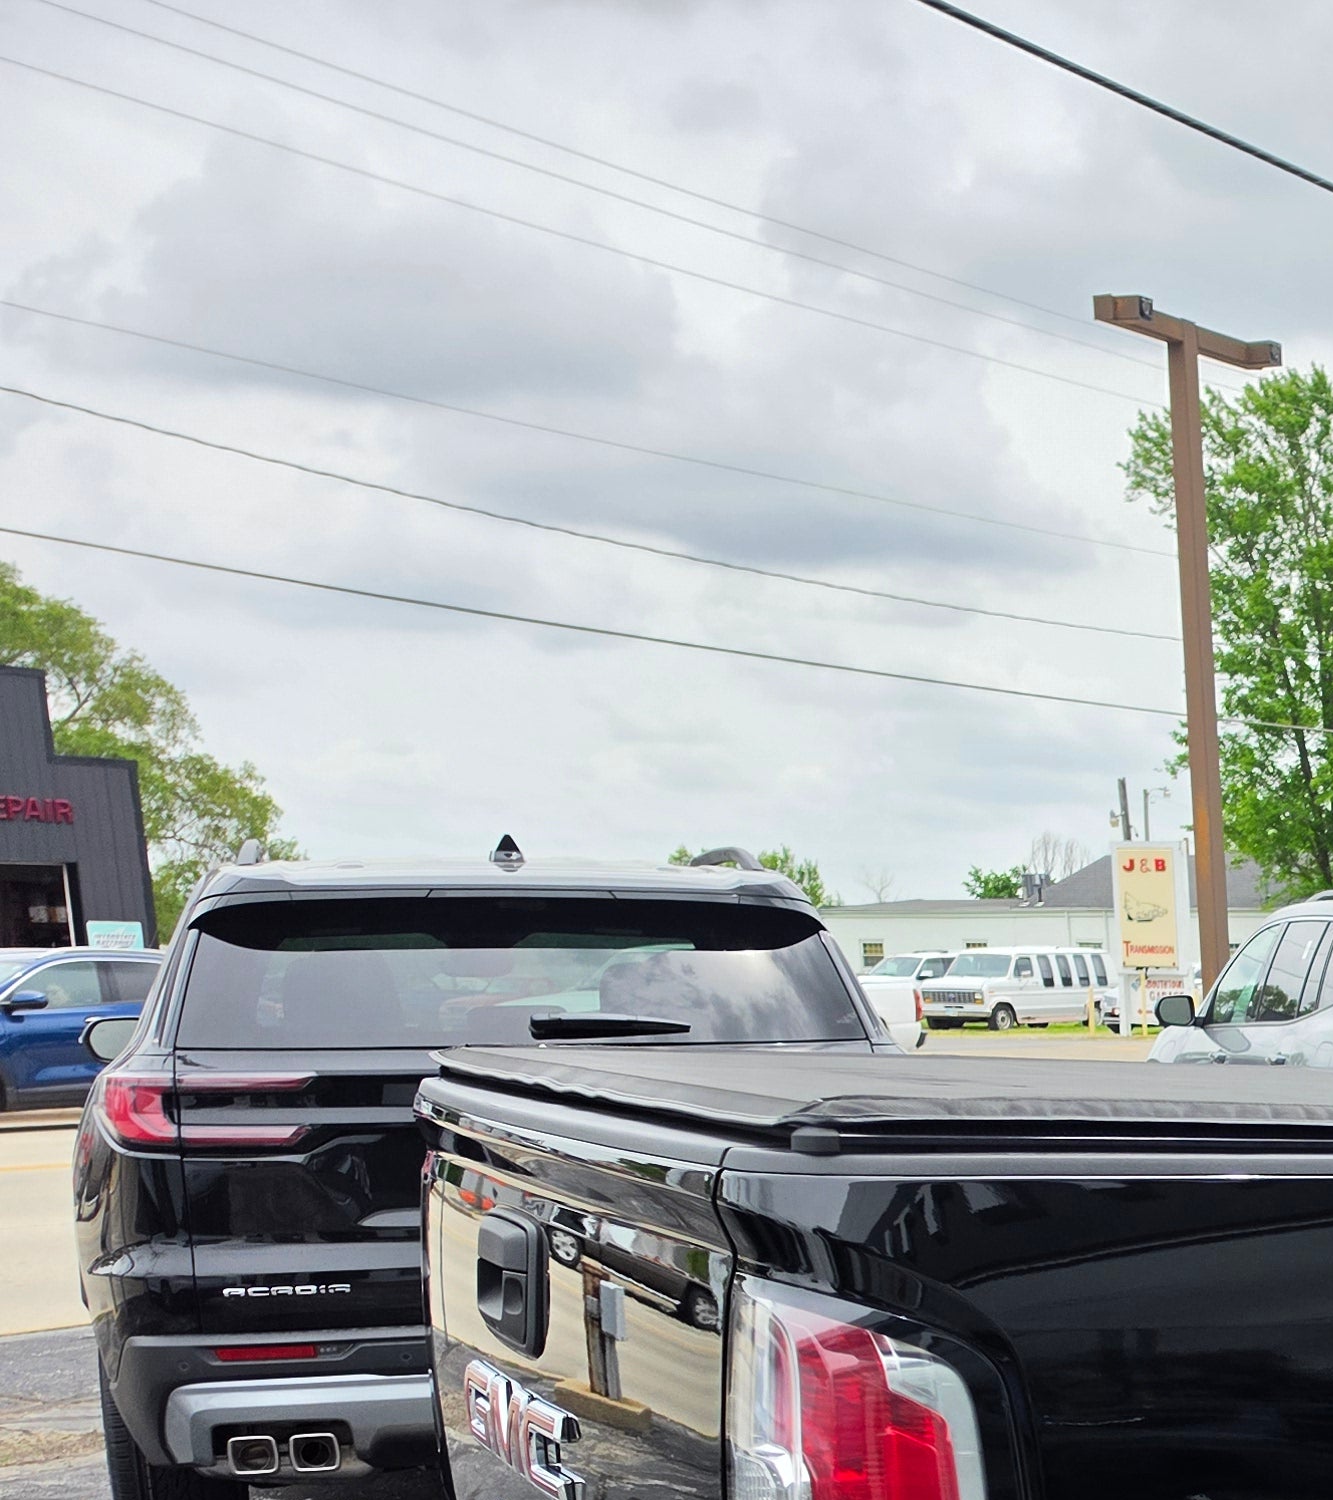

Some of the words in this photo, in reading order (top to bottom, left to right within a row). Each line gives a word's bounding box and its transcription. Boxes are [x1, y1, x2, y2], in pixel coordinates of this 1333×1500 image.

[1123, 859, 1135, 872] J
[1140, 858, 1152, 873] &
[1154, 858, 1167, 872] B
[1123, 941, 1175, 957] TRANSMISSION
[222, 1284, 351, 1297] ACADIA
